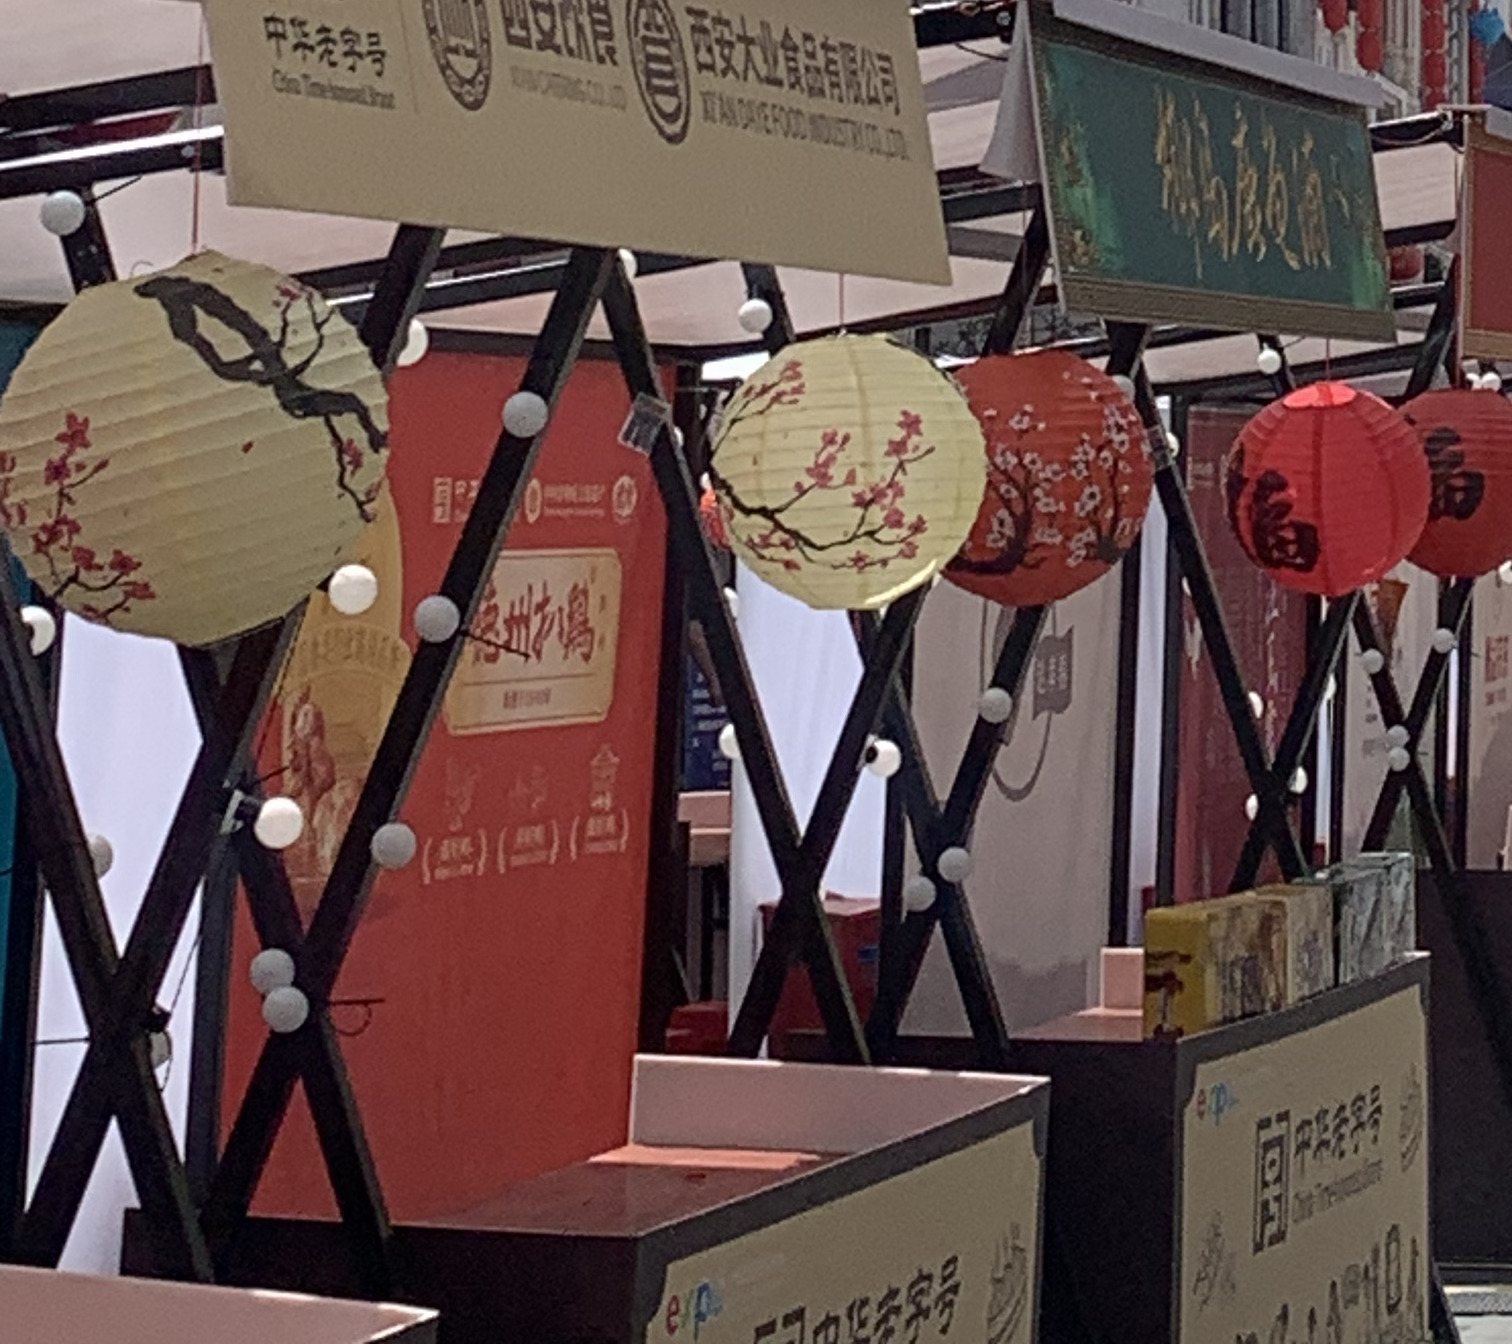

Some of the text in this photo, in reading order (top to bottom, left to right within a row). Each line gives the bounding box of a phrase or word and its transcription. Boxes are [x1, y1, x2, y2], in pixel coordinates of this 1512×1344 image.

[263, 13, 387, 78] 中华老字号
[685, 5, 900, 116] 西安大业食品有限公司
